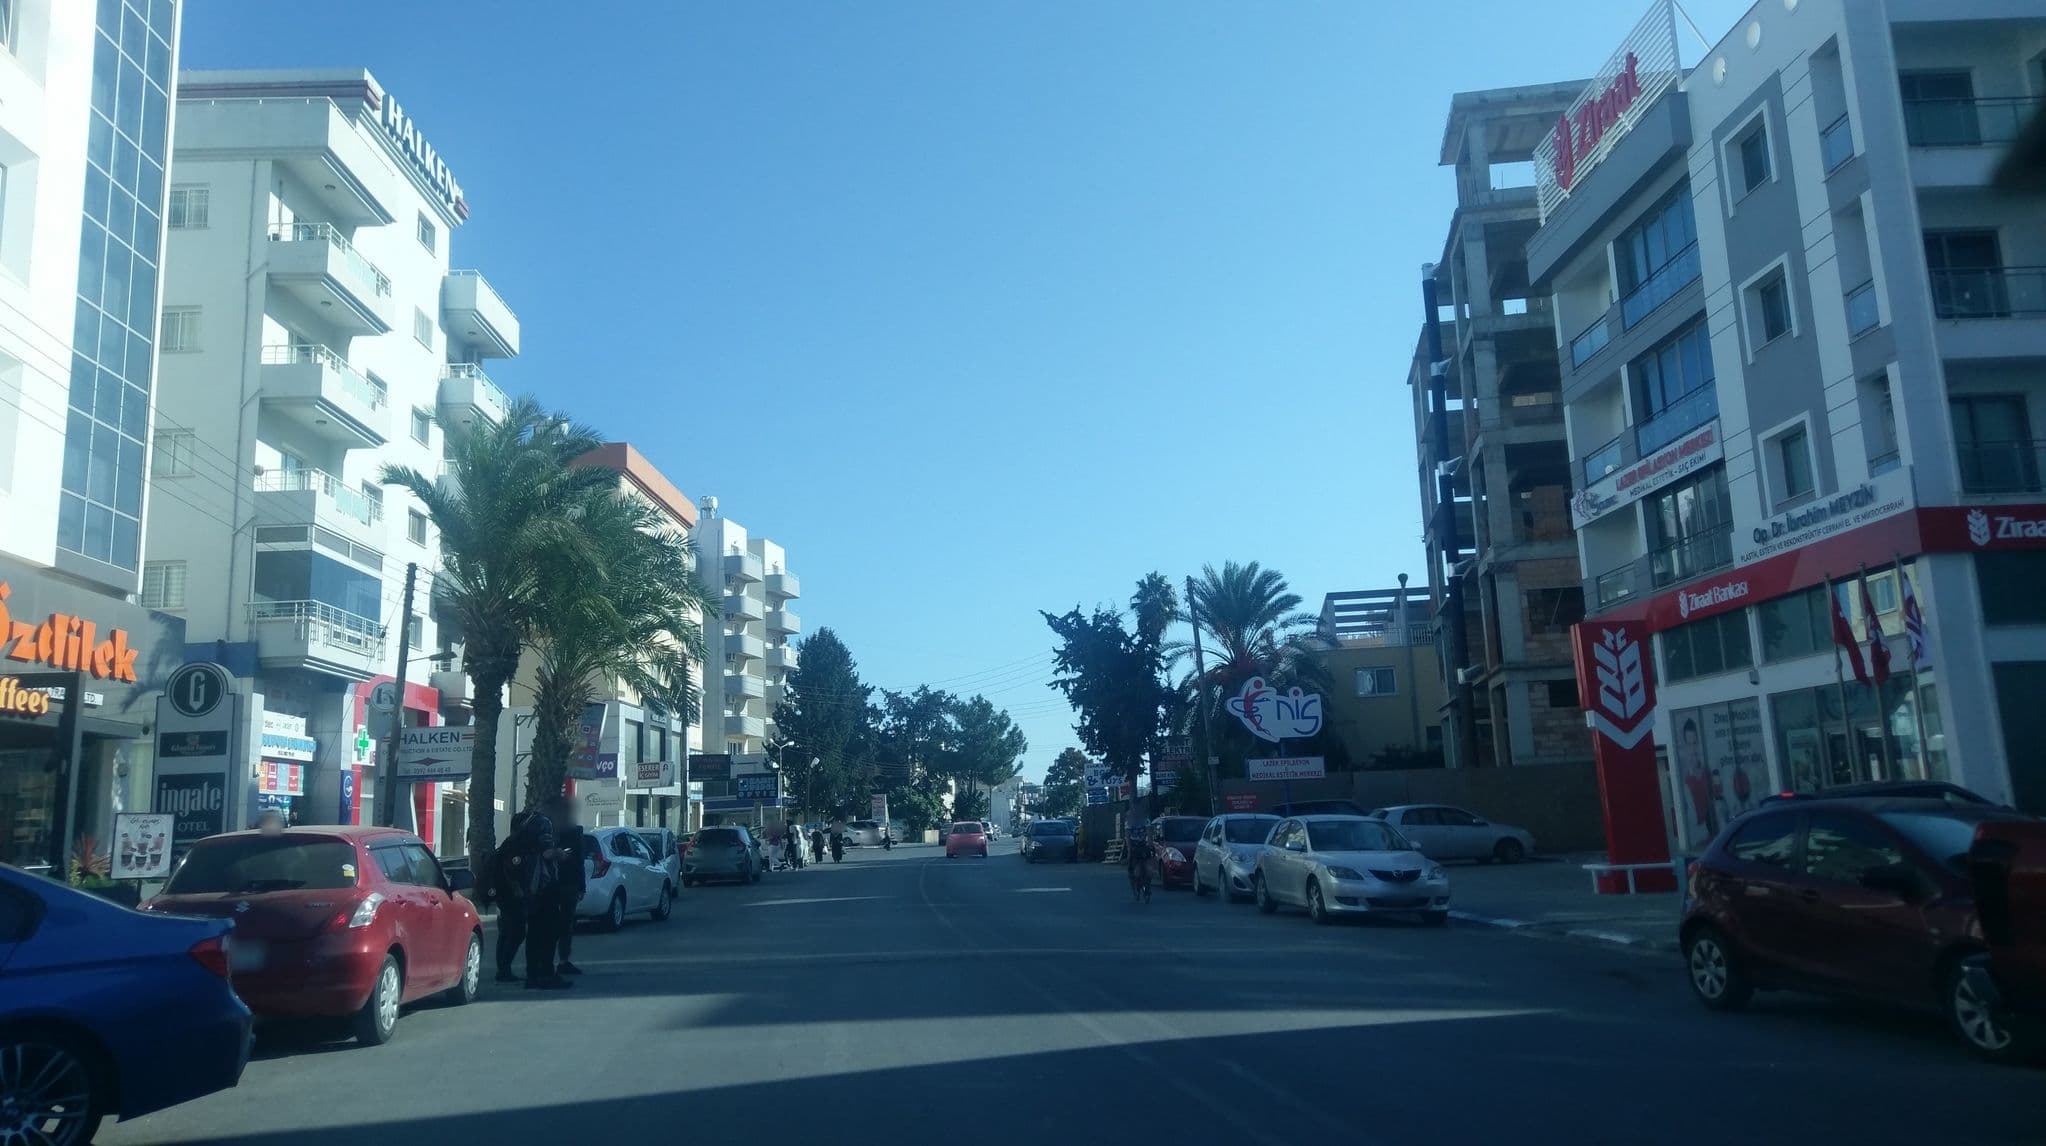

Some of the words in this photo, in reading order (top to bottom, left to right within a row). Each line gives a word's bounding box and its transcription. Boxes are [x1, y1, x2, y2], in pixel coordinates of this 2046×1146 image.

[382, 94, 457, 205] HALKEN
[1753, 527, 1769, 545] Op.
[1771, 521, 1786, 538] Dr.
[1689, 588, 1714, 611] Ziraat
[1713, 581, 1748, 604] Bankası
[400, 731, 460, 745] HALKEN
